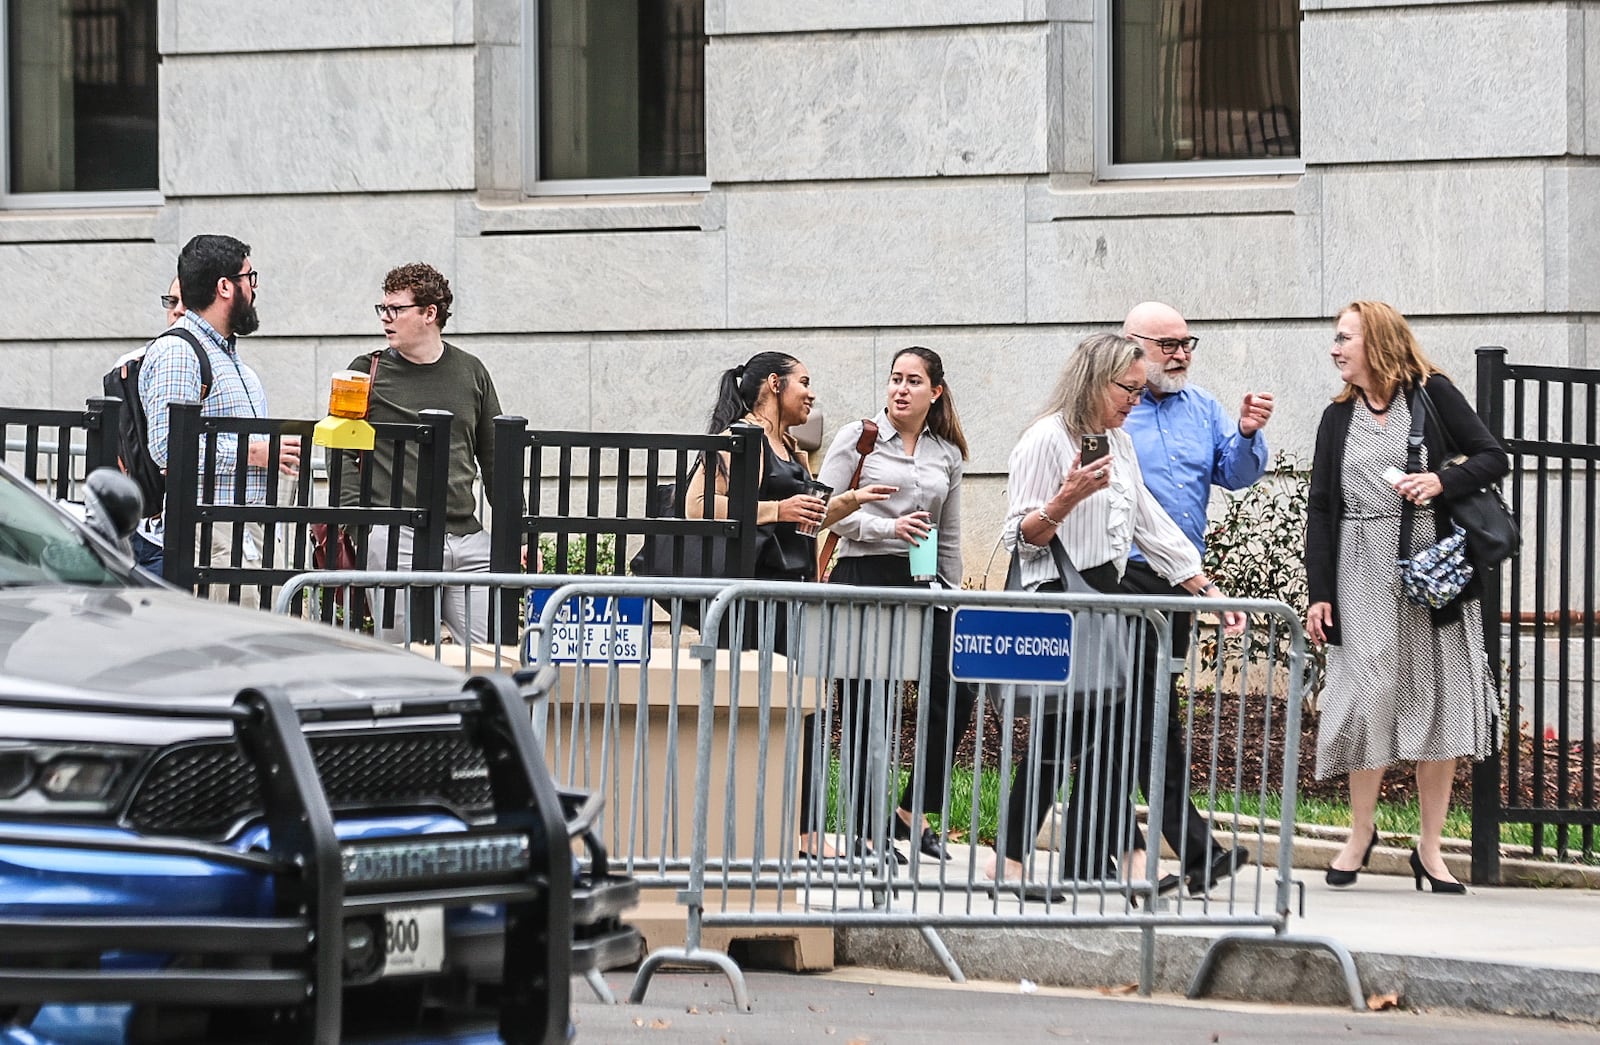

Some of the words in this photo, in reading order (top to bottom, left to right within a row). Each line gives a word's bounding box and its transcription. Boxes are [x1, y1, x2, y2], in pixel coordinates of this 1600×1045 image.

[552, 627, 594, 641] POLIE
[604, 628, 629, 642] LNE
[954, 633, 993, 655] STATE
[995, 635, 1013, 655] OF
[1014, 636, 1070, 657] GEORGIA
